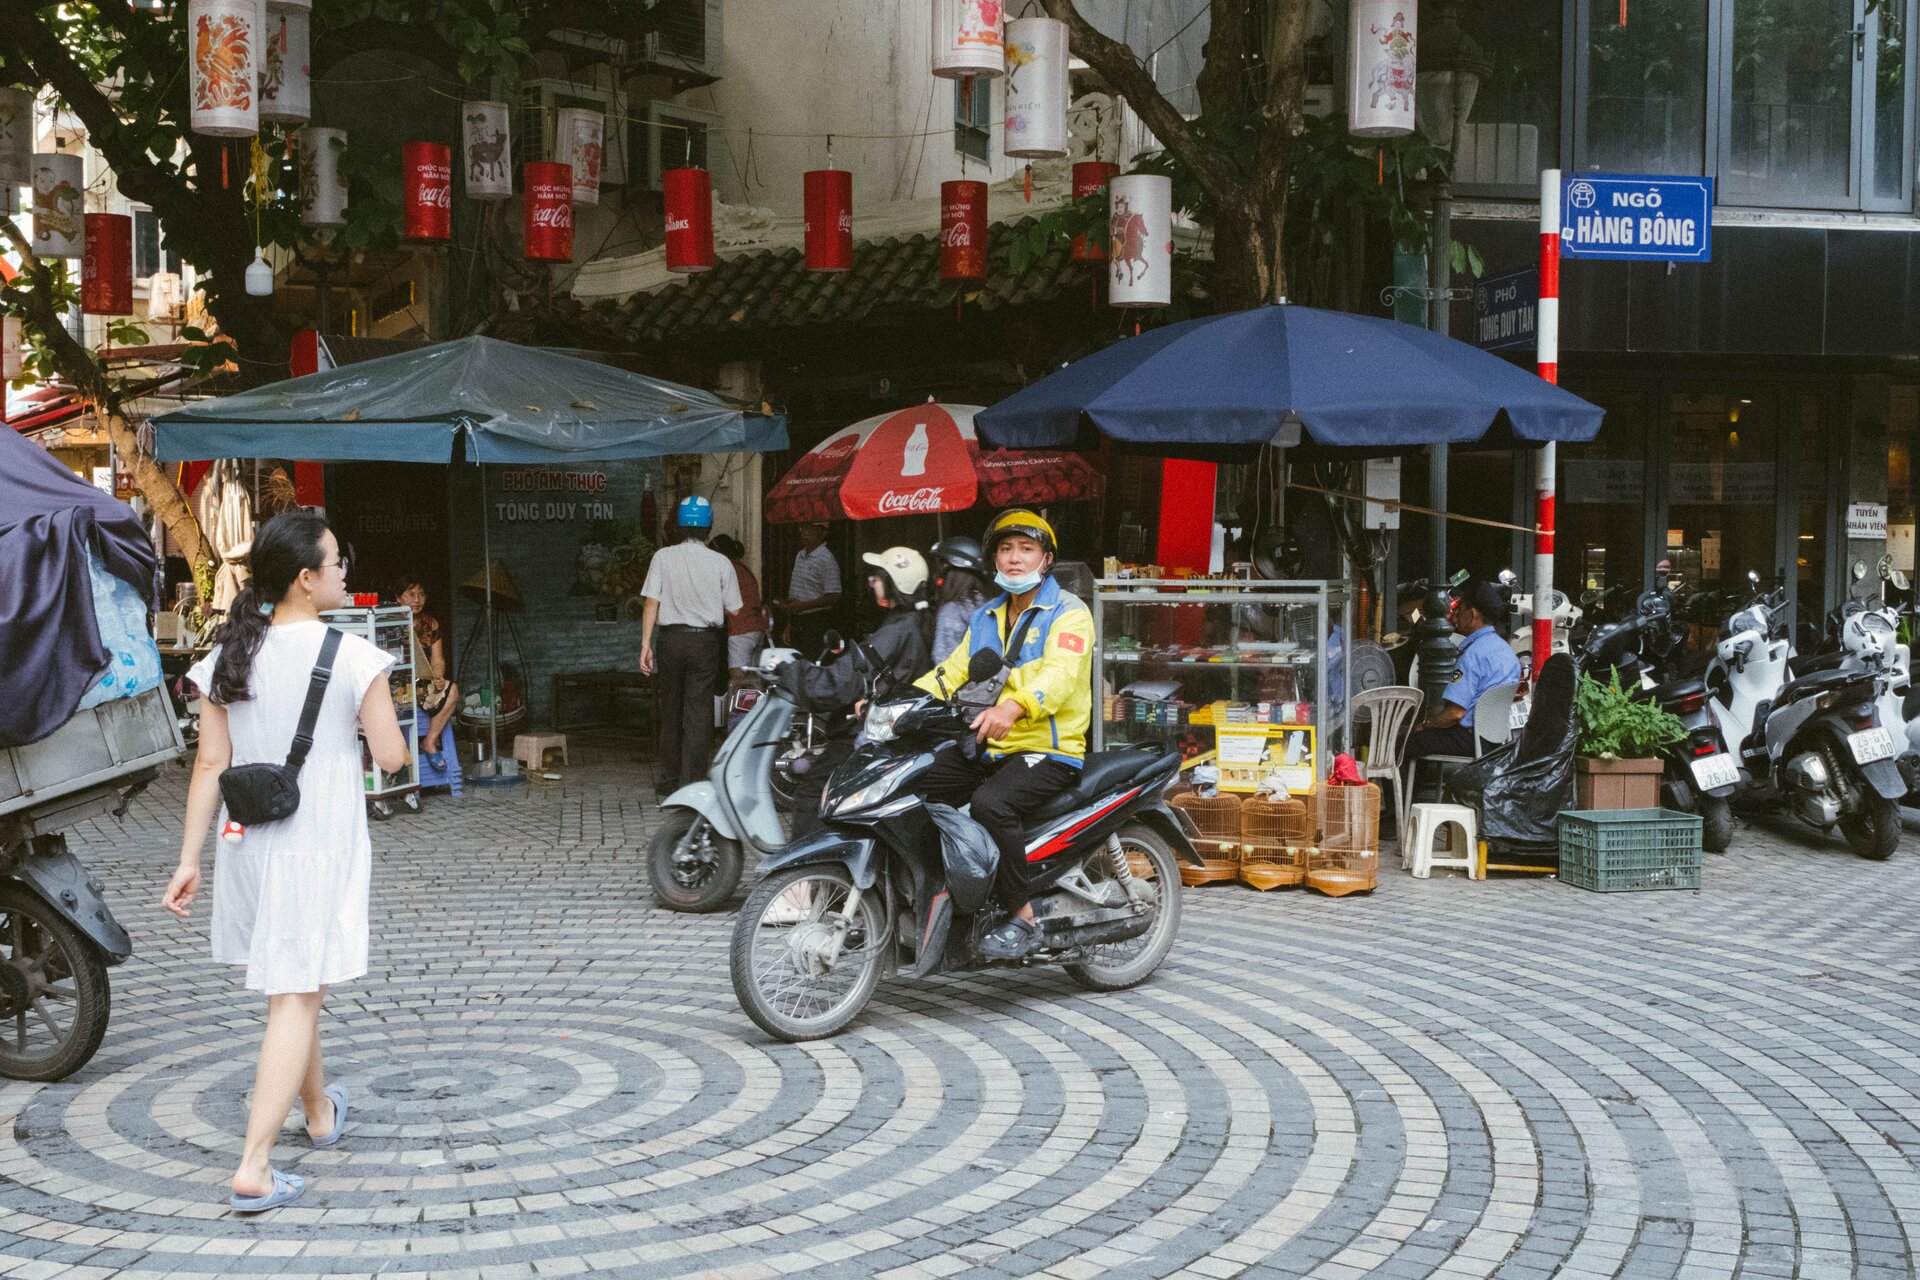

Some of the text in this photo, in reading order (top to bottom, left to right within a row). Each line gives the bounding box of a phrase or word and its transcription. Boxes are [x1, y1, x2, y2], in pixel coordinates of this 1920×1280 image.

[532, 184, 552, 192] CHÚC
[1612, 188, 1662, 208] NGÕ
[1577, 210, 1695, 246] HÀNG BÔNG
[1494, 278, 1518, 304] PHỐ
[1479, 301, 1535, 342] TỐNG DUY TÂN
[880, 378, 890, 395] 9
[566, 471, 607, 495] THỰC
[545, 502, 577, 520] DUY
[582, 500, 614, 520] TÂN
[878, 486, 945, 513] Coca-Cola
[1846, 520, 1887, 531] NHÂN VIÊN
